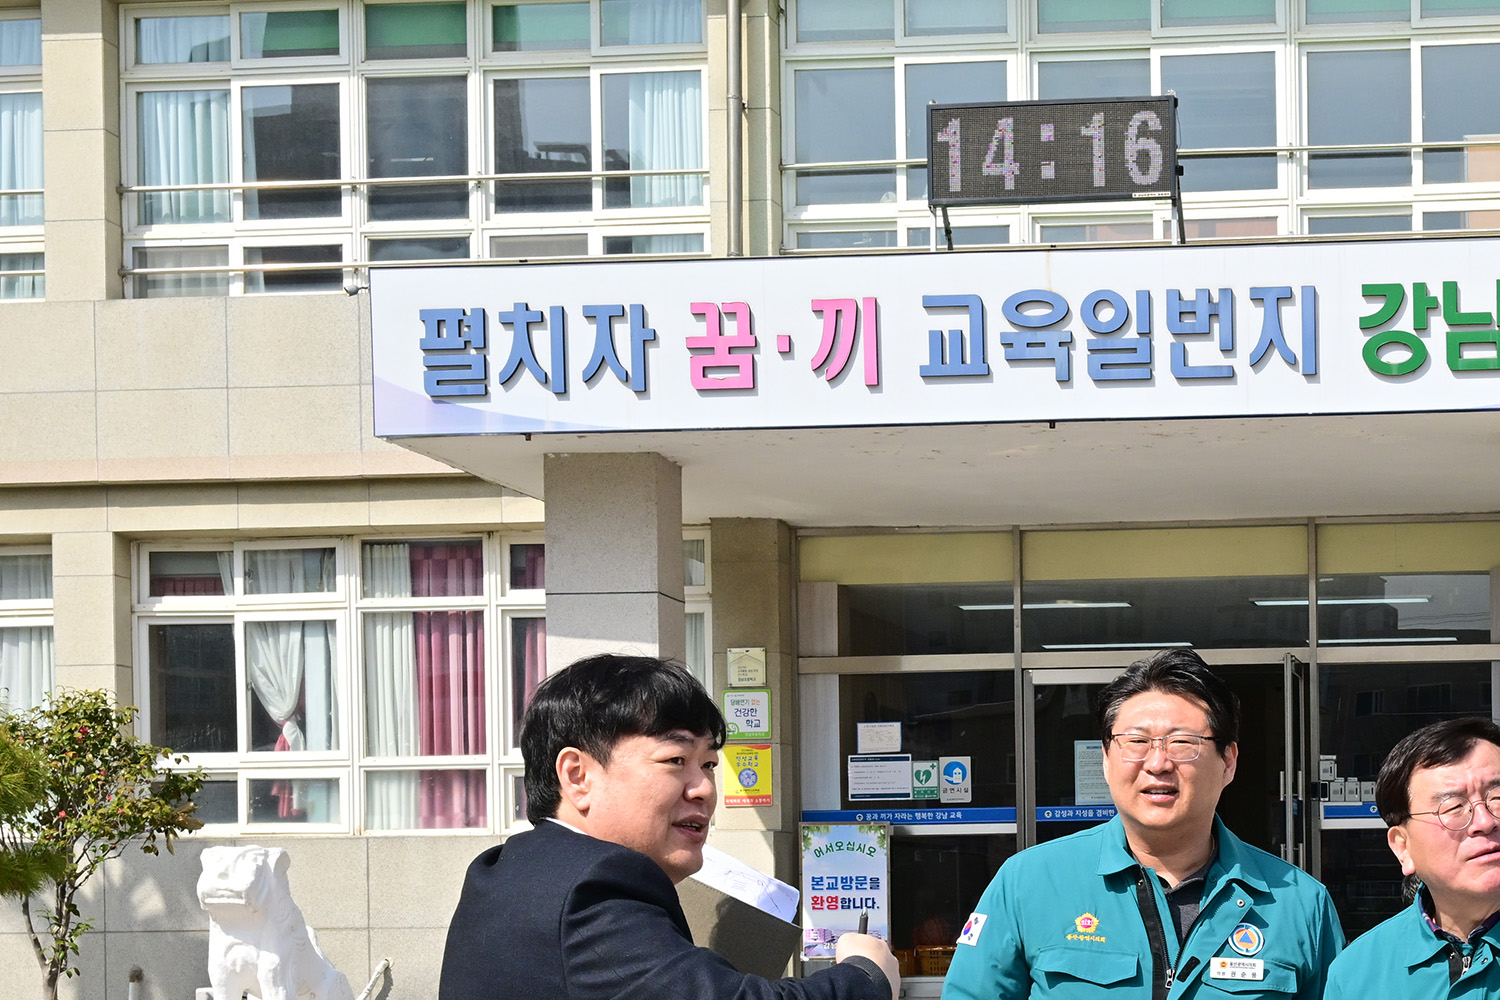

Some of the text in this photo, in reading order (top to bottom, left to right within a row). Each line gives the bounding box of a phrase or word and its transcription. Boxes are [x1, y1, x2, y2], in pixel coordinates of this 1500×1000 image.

[937, 111, 1163, 192] 14:16
[419, 302, 657, 397] 펼치자
[686, 297, 881, 391] 꿈·끼
[920, 285, 1320, 383] 교육일번지
[734, 708, 757, 717] 건강한
[746, 719, 761, 728] 학교
[894, 812, 913, 820] 자라는
[915, 812, 933, 820] 행복한
[935, 811, 948, 820] 강남
[949, 811, 962, 819] 교육
[1055, 809, 1115, 818] 감성과 지성을 겸비한
[813, 841, 877, 858] 어서오십시오
[811, 876, 880, 890] 본교방문을
[811, 895, 880, 910] 환영합니다.
